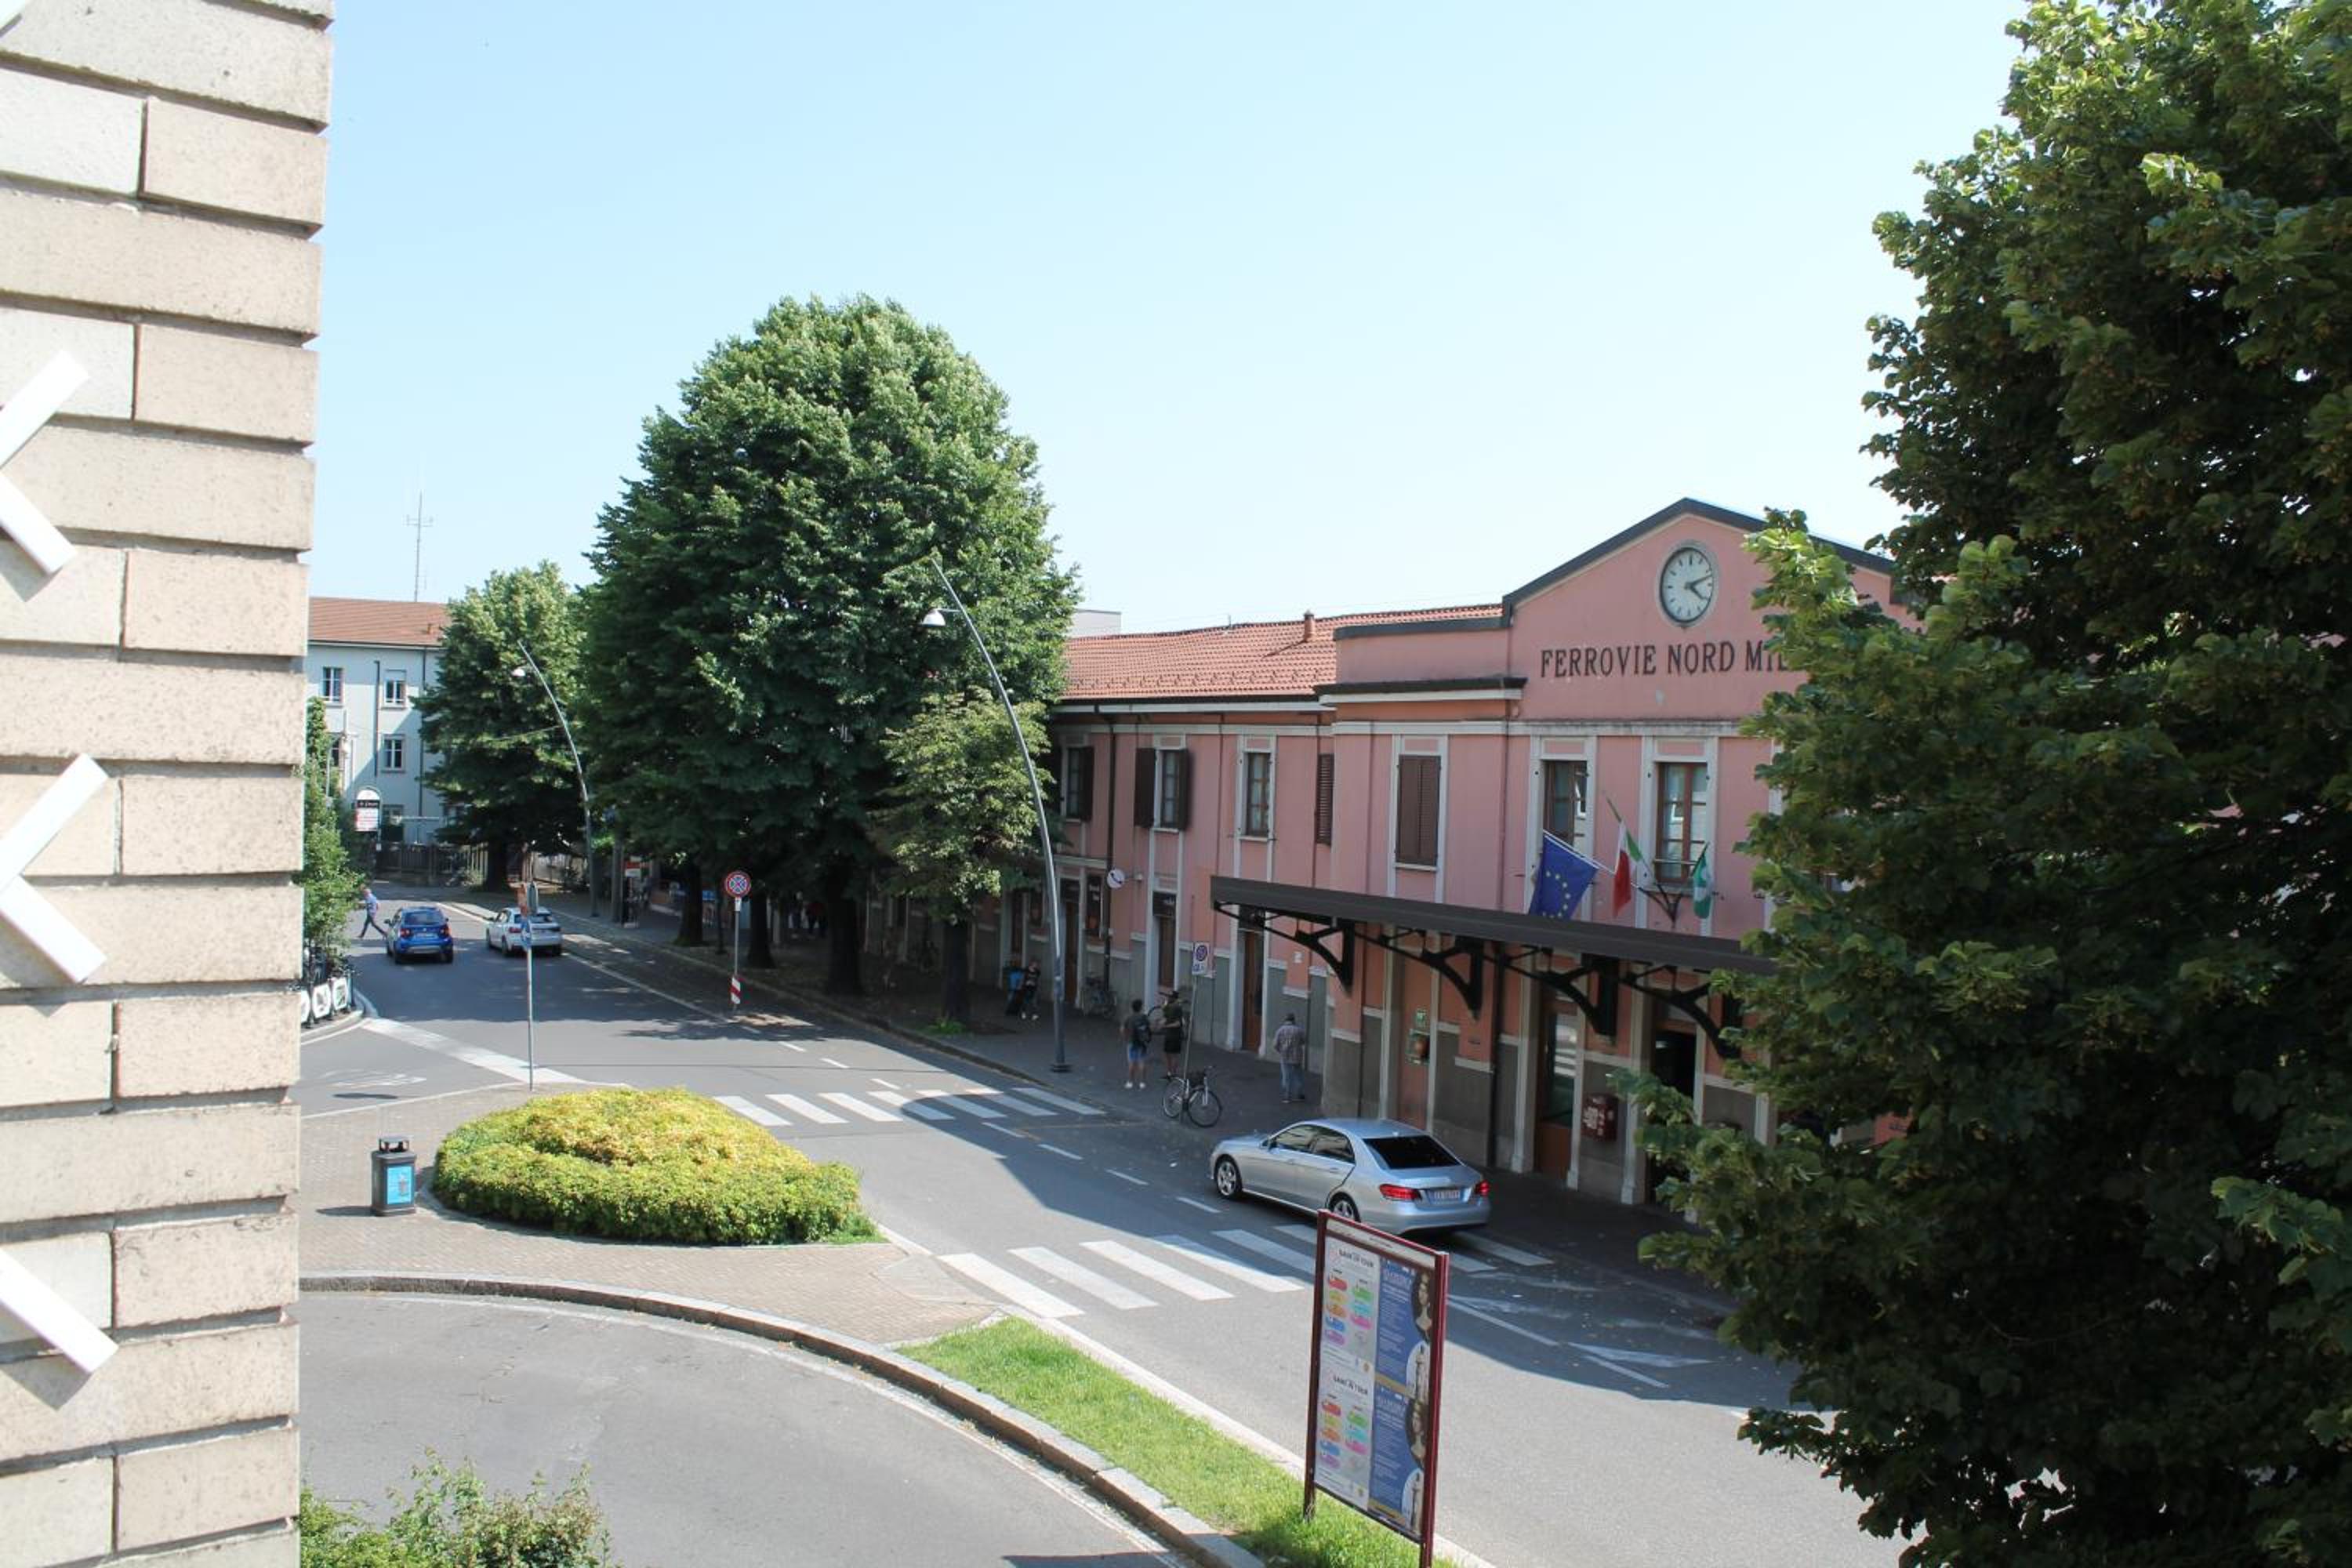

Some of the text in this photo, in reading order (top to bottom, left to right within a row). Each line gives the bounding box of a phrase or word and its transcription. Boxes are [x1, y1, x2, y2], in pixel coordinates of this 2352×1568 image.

[1541, 639, 1789, 678] FERROVIE NORD MIL
